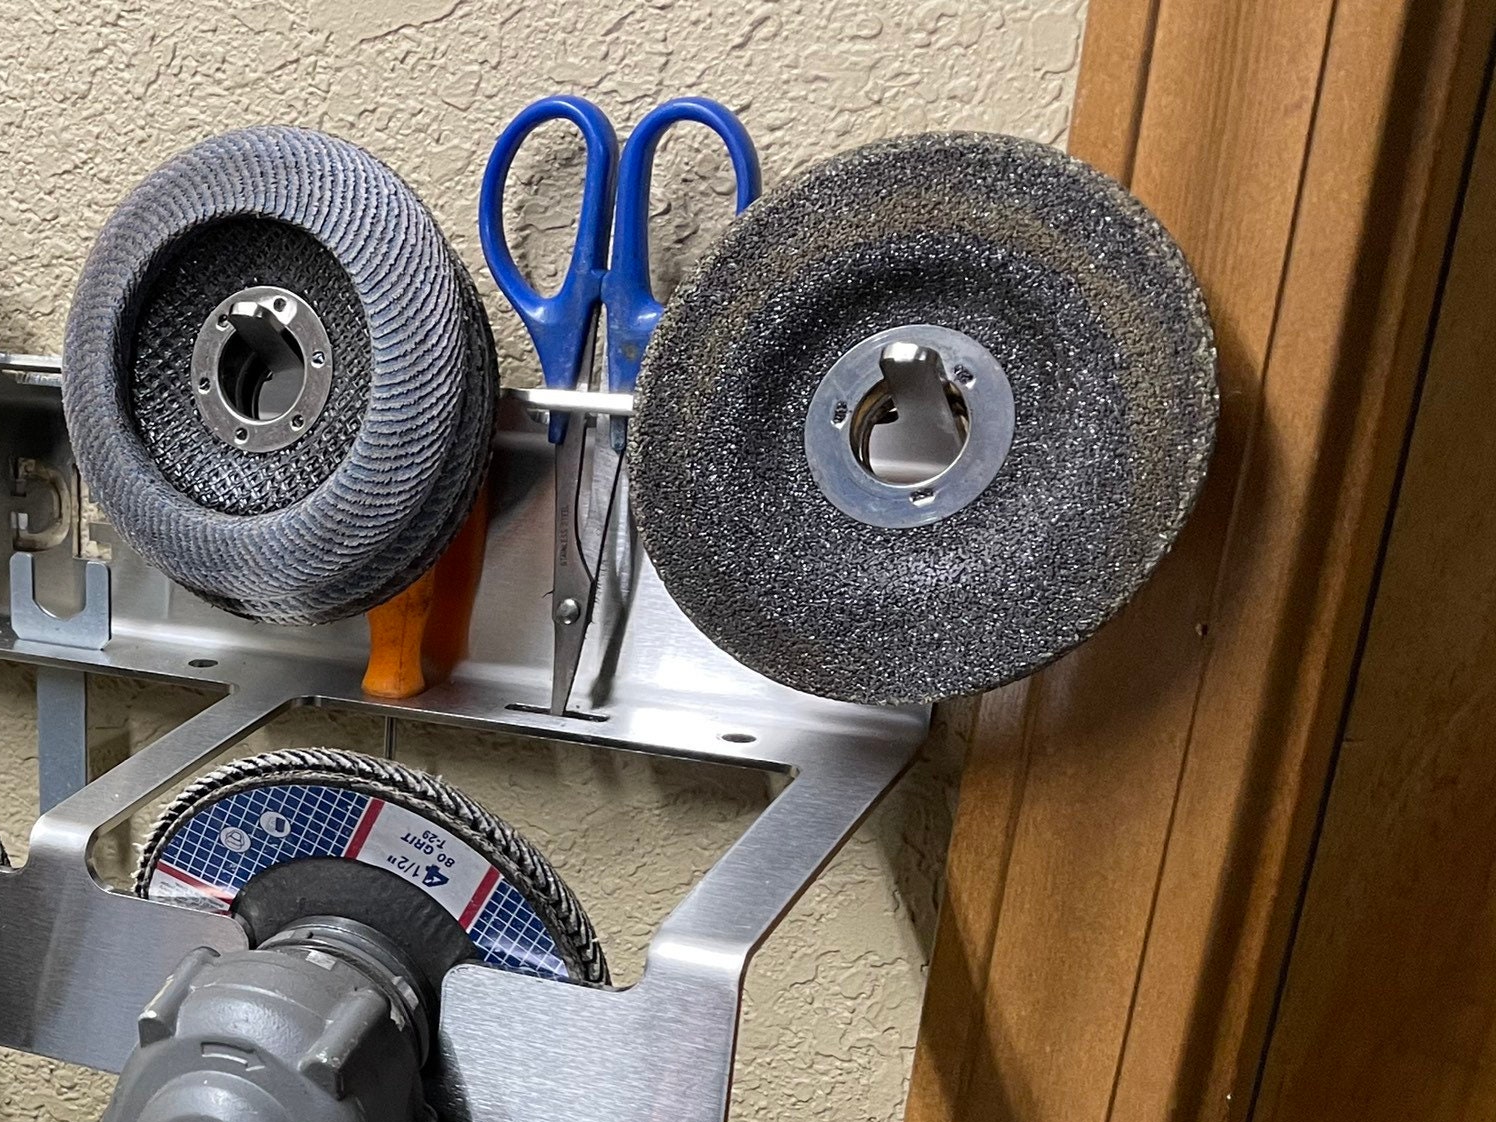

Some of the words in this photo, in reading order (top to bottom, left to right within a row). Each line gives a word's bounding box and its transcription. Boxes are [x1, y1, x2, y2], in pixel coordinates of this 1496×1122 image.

[400, 833, 434, 855] GRIT
[422, 830, 445, 848] T-29
[435, 851, 455, 869] 80
[421, 863, 449, 887] 4
